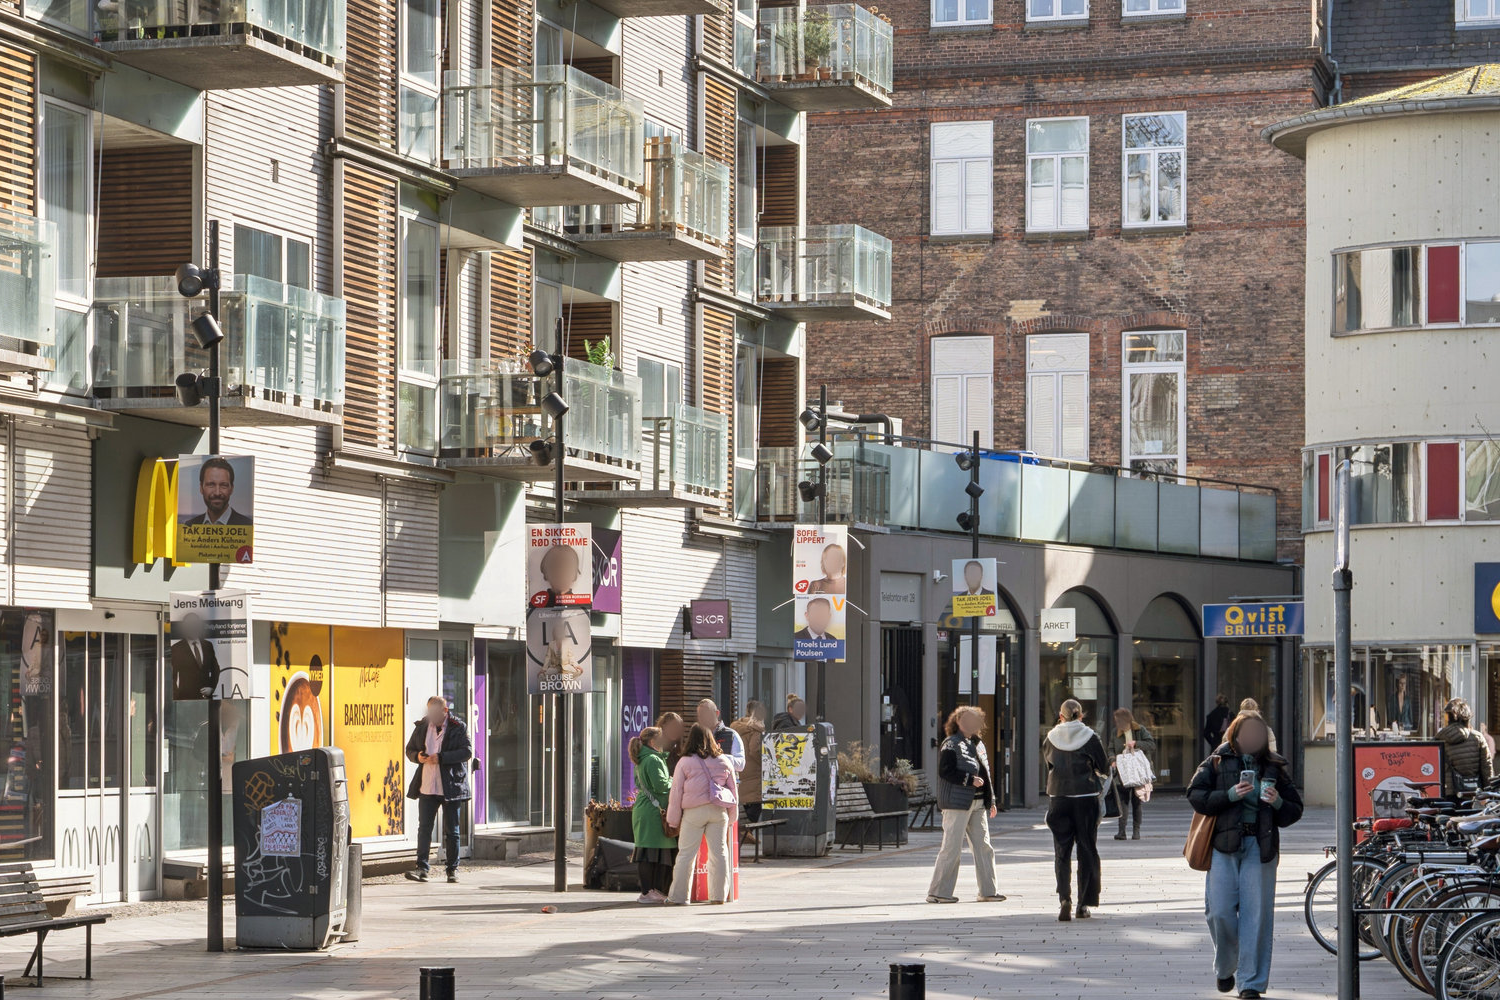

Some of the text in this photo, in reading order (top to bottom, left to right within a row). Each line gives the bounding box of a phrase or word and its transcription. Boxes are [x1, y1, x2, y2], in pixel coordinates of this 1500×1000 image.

[183, 527, 247, 536] TAK JENS JOEL
[531, 528, 576, 537] EN SIKKER
[531, 538, 588, 547] RØD STEMME
[798, 582, 807, 590] SF
[174, 599, 244, 609] Jens Meilvang
[534, 595, 546, 604] SF
[1225, 604, 1285, 625] Qvist
[695, 615, 724, 624] SKOR
[1044, 622, 1070, 630] ARKET
[1225, 624, 1286, 635] BRILLER
[359, 663, 380, 689] McCafé
[540, 680, 582, 690] BROWN
[221, 683, 244, 700] LA
[344, 704, 394, 726] BARISTAKAFFE
[623, 705, 649, 732] SKOR
[1380, 751, 1411, 760] Treasure
[1388, 758, 1404, 766] Days
[775, 800, 788, 808] NOT
